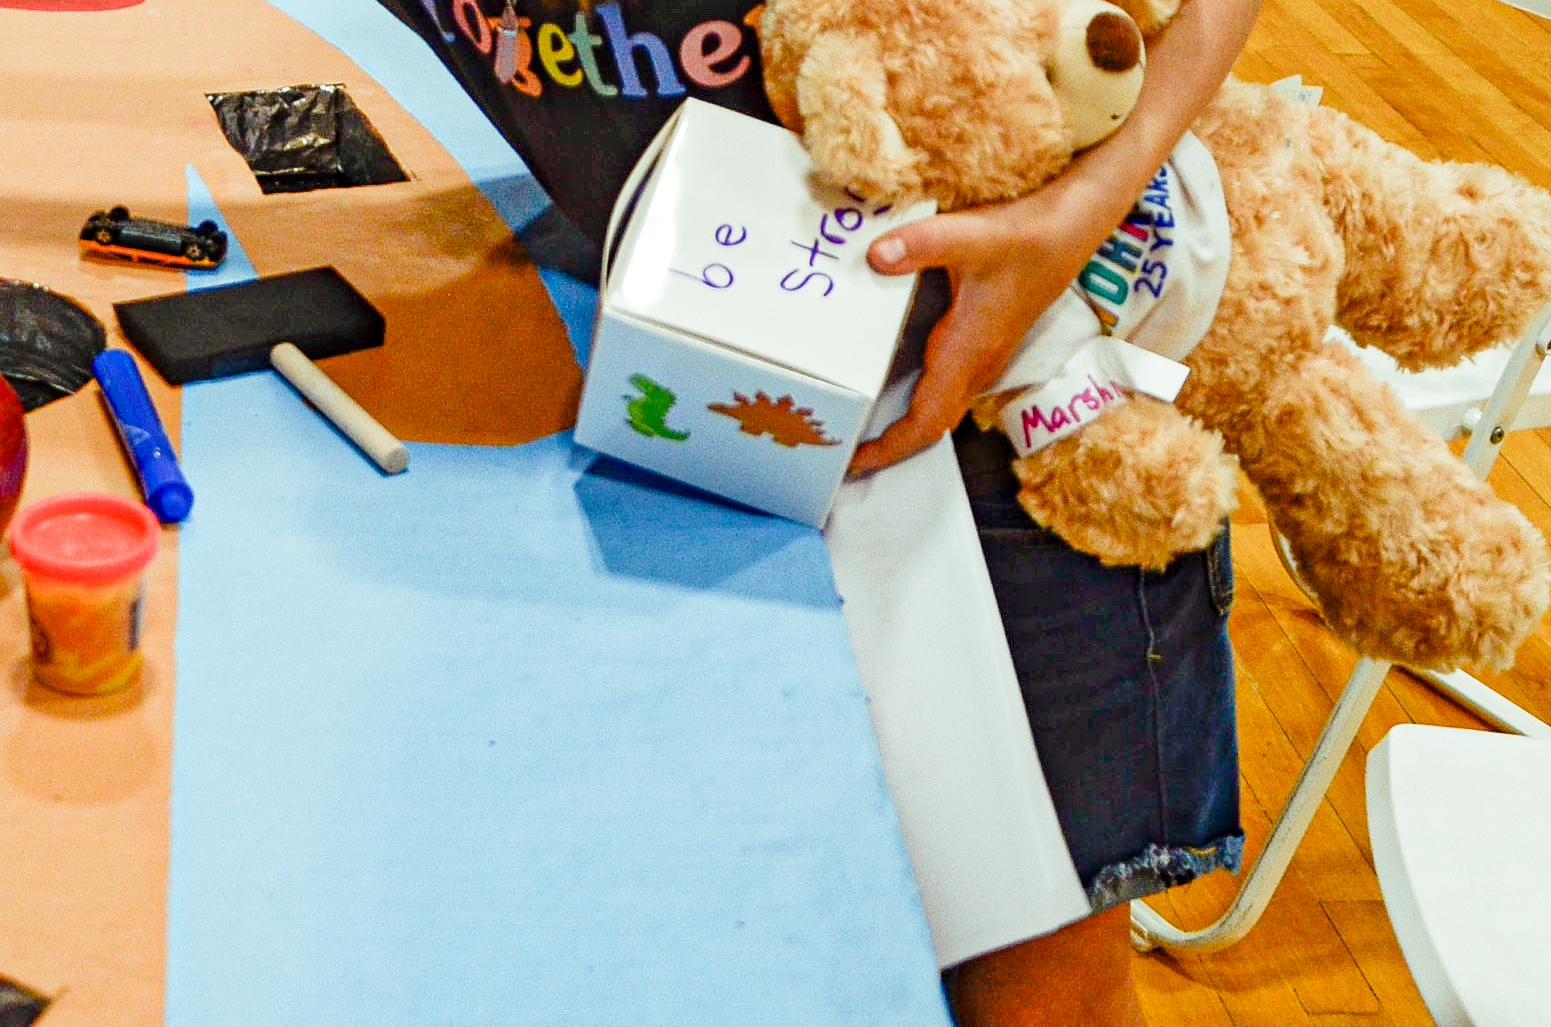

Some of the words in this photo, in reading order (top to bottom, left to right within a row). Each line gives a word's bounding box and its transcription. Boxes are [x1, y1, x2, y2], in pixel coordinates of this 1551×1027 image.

[668, 224, 747, 289] be
[780, 186, 893, 297] Stro
[1134, 260, 1167, 298] 25
